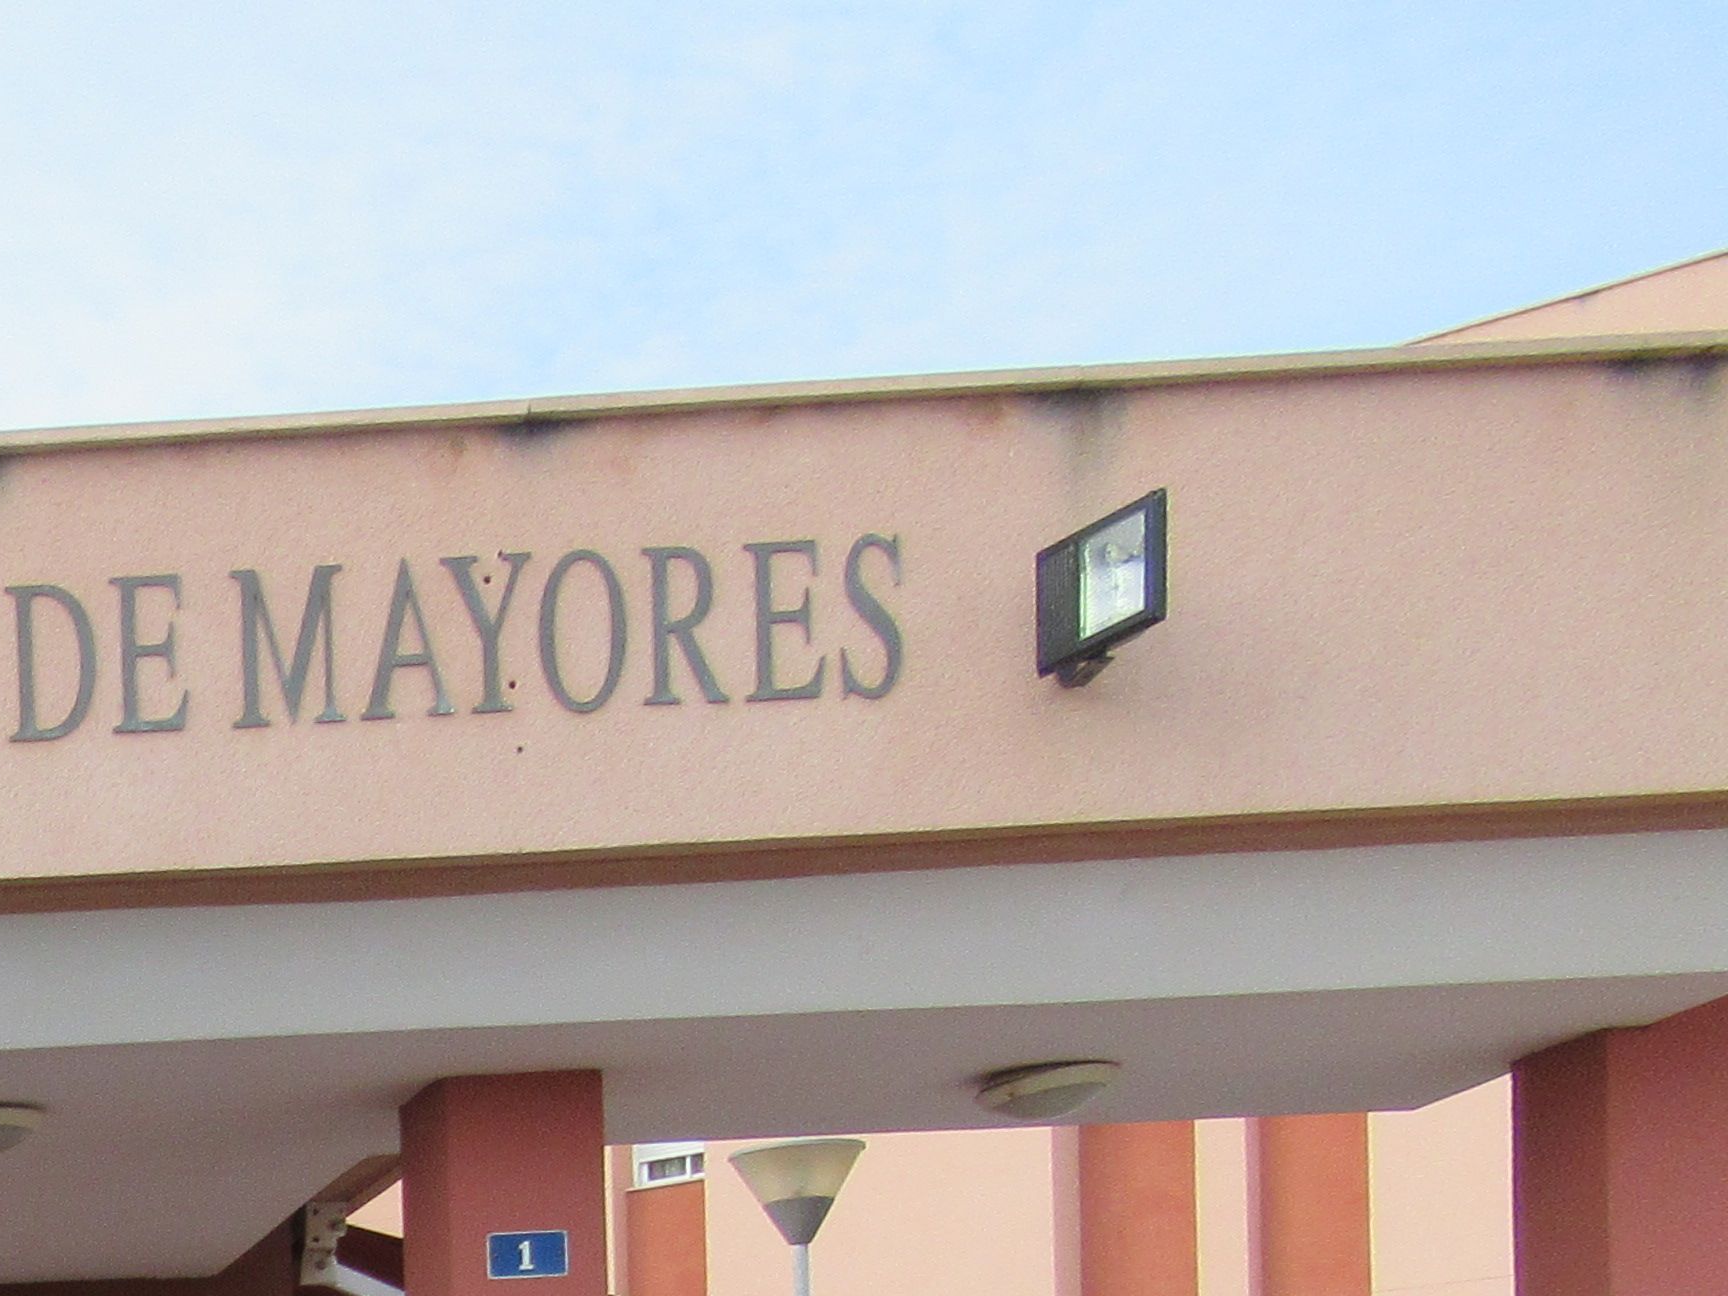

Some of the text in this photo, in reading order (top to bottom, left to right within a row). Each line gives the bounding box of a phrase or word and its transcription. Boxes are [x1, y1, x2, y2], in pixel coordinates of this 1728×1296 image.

[5, 573, 190, 743] DE
[228, 533, 905, 729] MAYORES
[518, 1241, 534, 1270] 1
